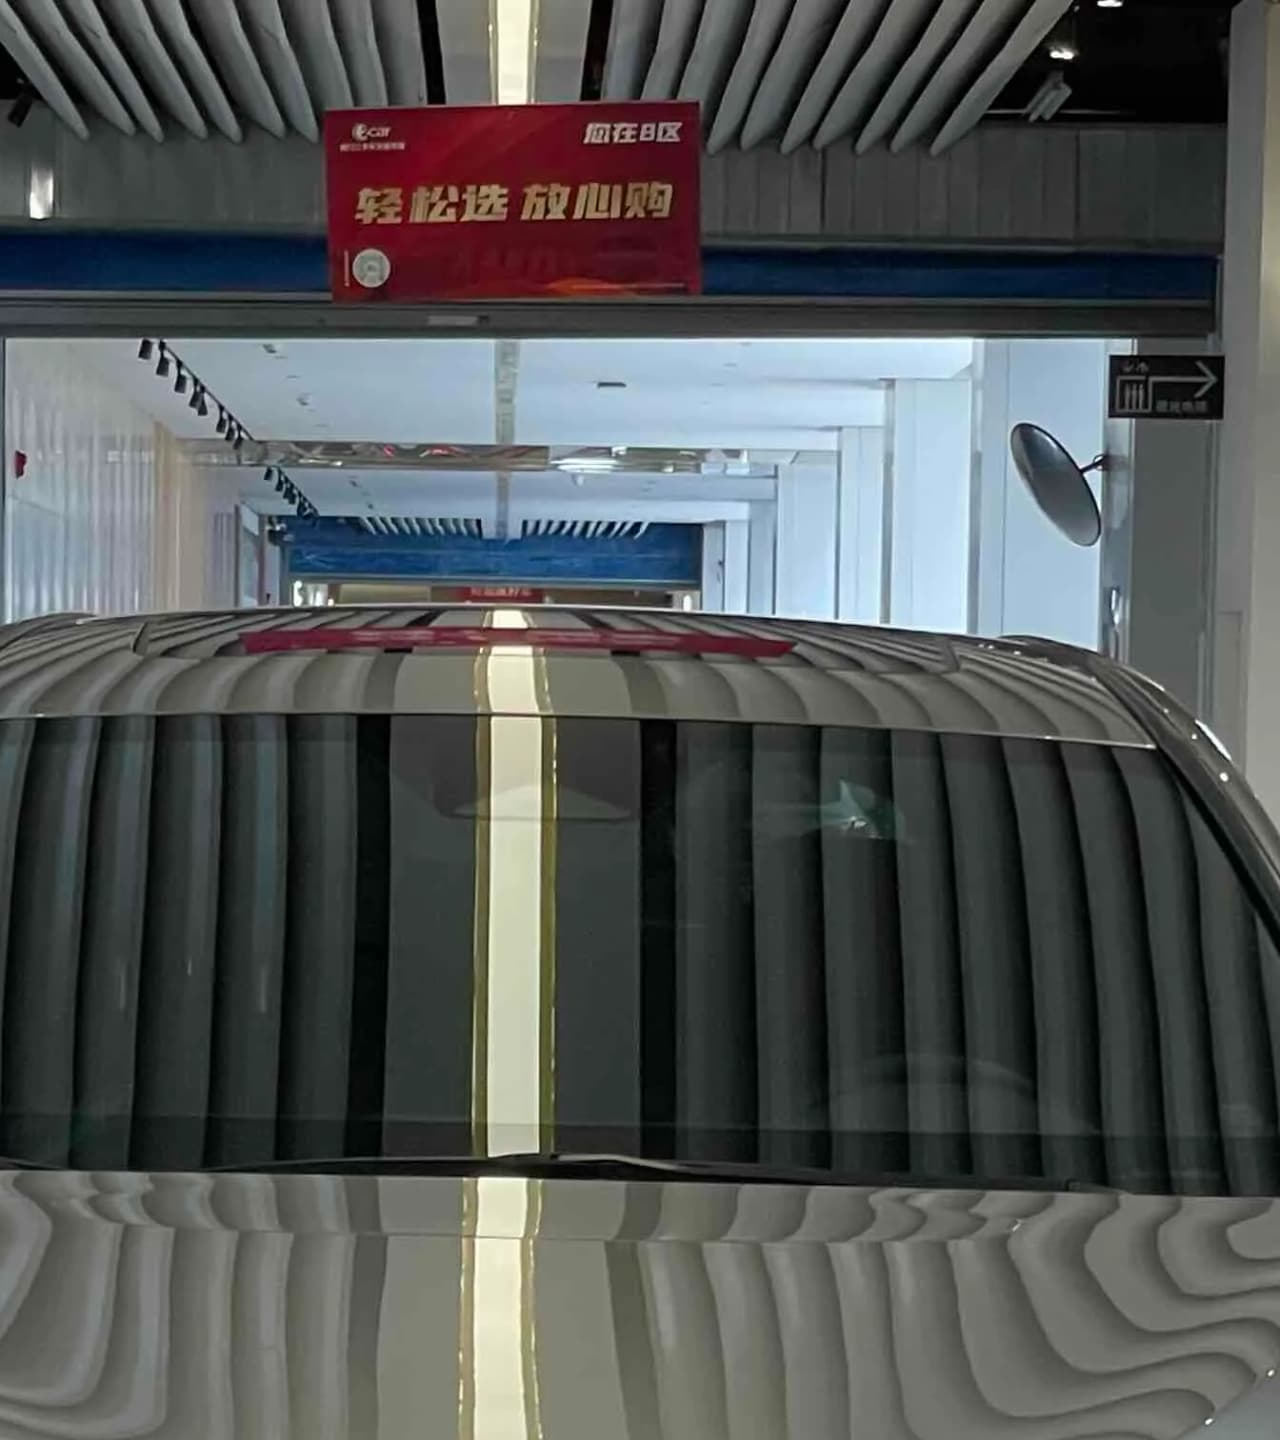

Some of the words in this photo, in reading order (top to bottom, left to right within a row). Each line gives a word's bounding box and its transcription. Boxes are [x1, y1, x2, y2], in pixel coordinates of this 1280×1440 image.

[355, 183, 508, 225] 轻松选
[520, 181, 673, 221] 放心购
